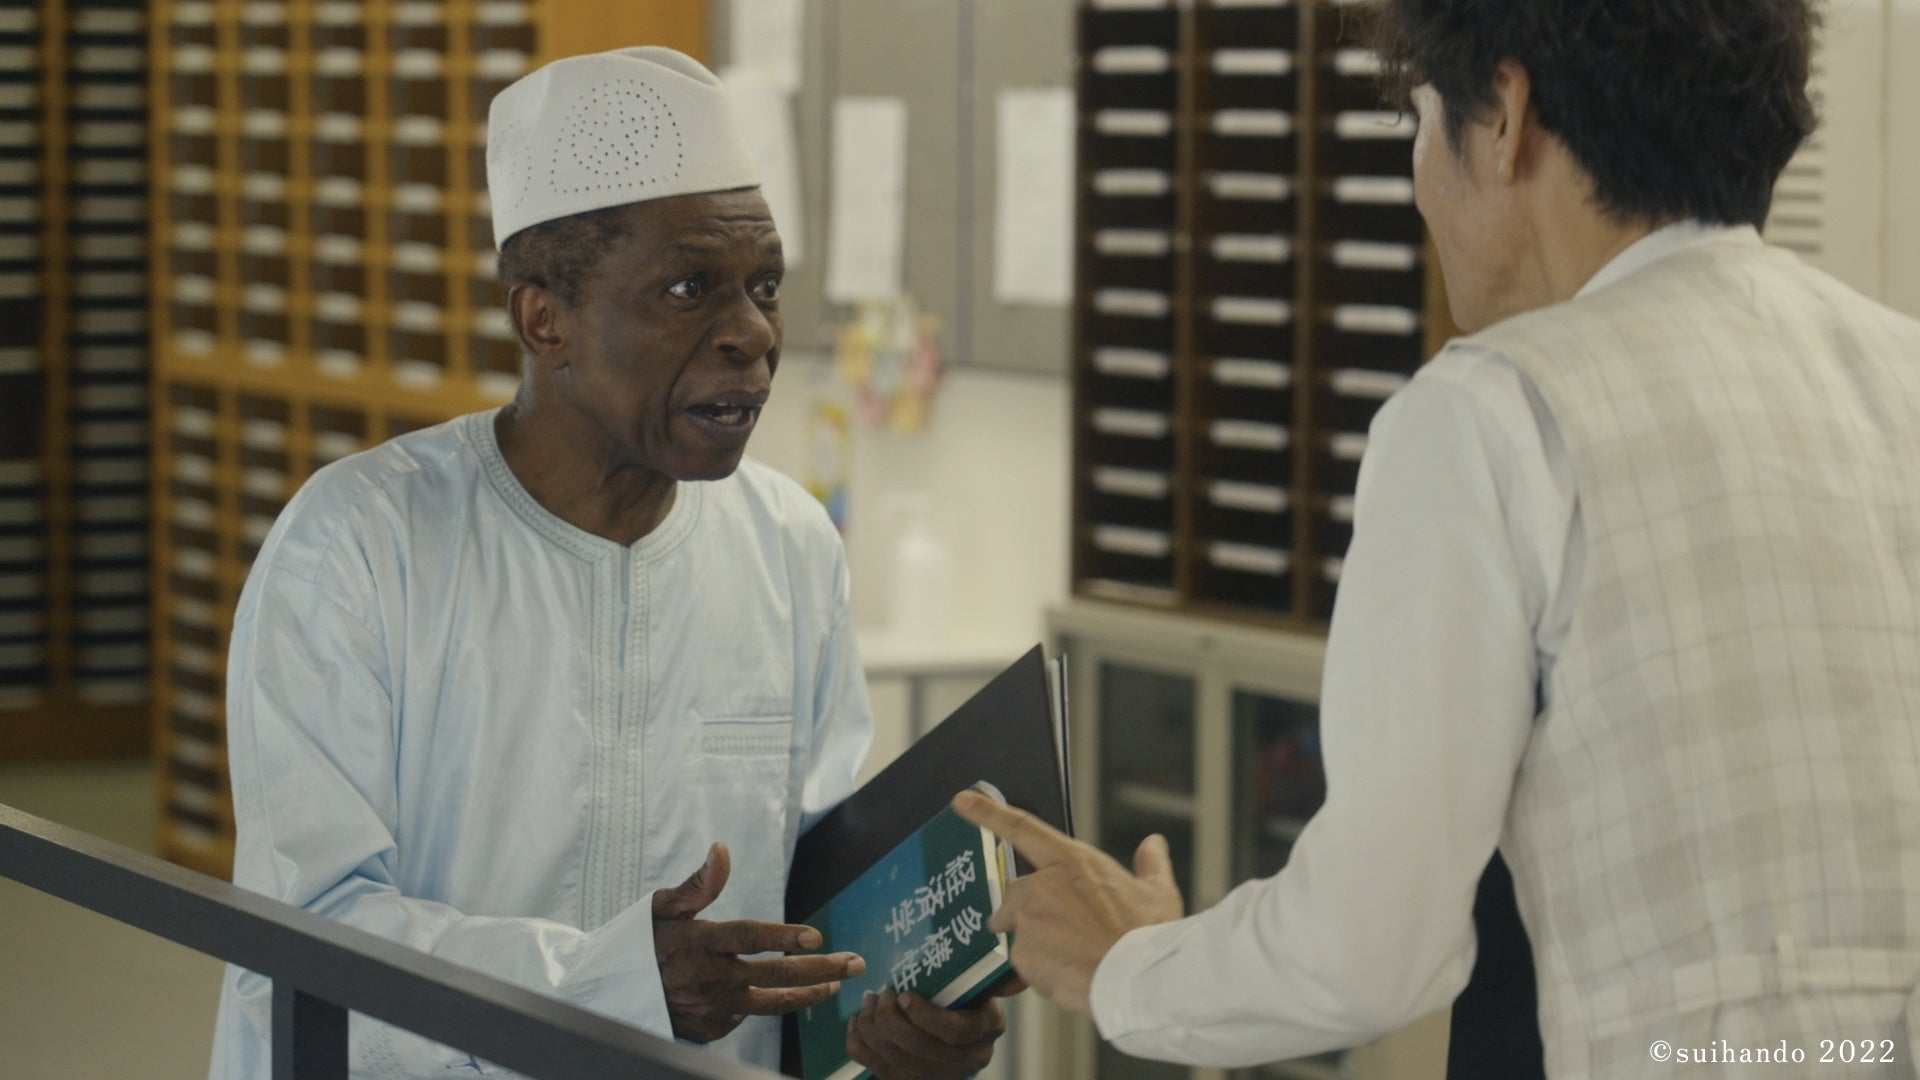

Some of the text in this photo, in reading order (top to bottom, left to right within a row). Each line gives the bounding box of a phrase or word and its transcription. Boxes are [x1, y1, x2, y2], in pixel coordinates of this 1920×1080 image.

[885, 850, 976, 943] 経済学
[863, 906, 983, 1000] 多様性
